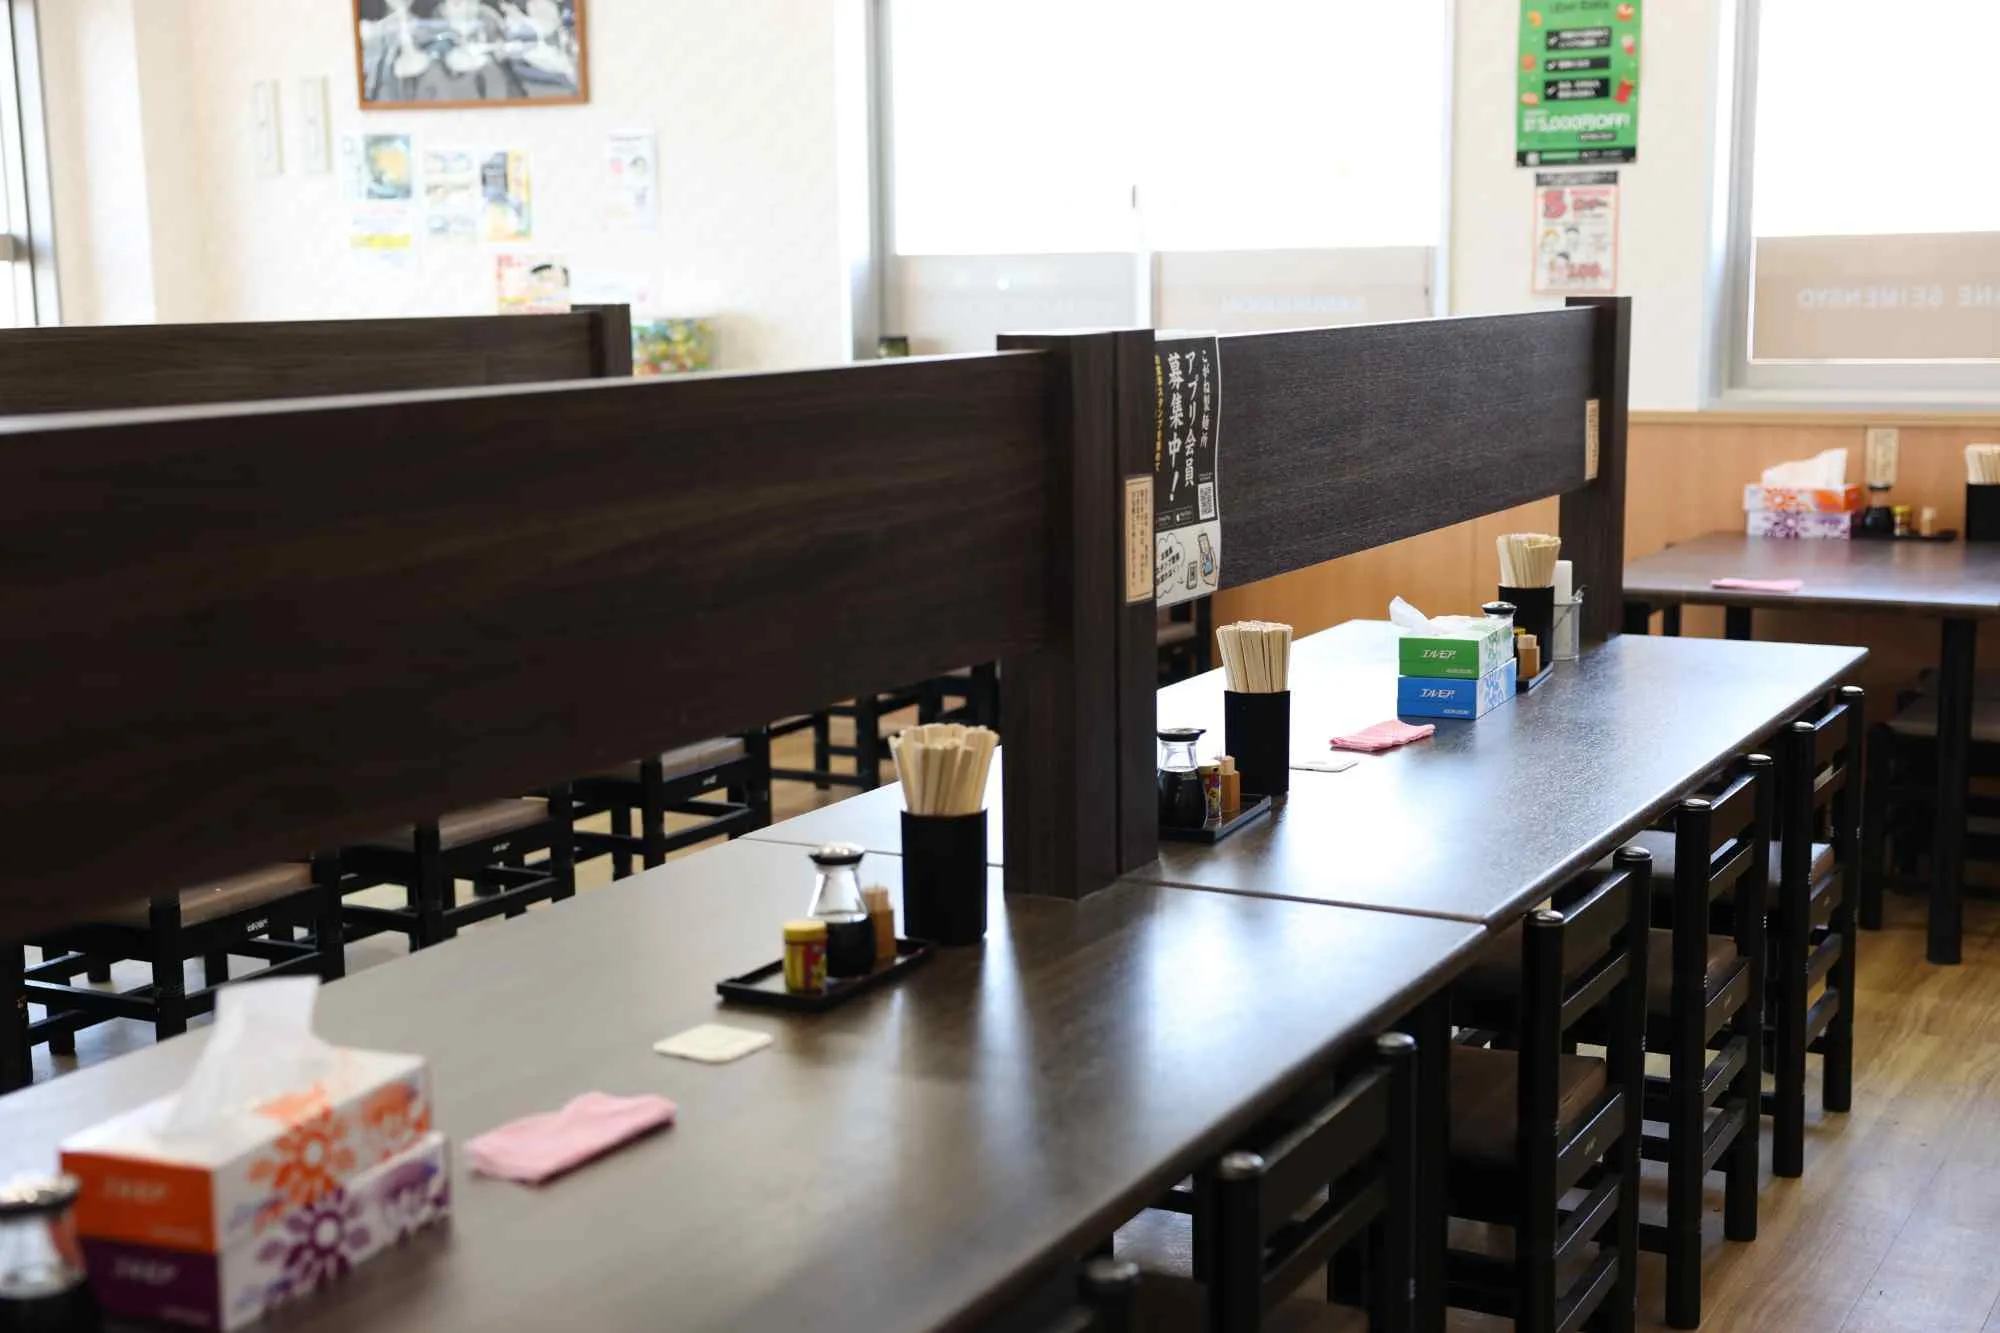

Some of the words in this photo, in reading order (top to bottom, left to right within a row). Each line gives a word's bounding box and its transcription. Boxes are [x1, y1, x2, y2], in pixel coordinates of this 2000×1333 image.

[1183, 350, 1199, 487] アプリ会員
